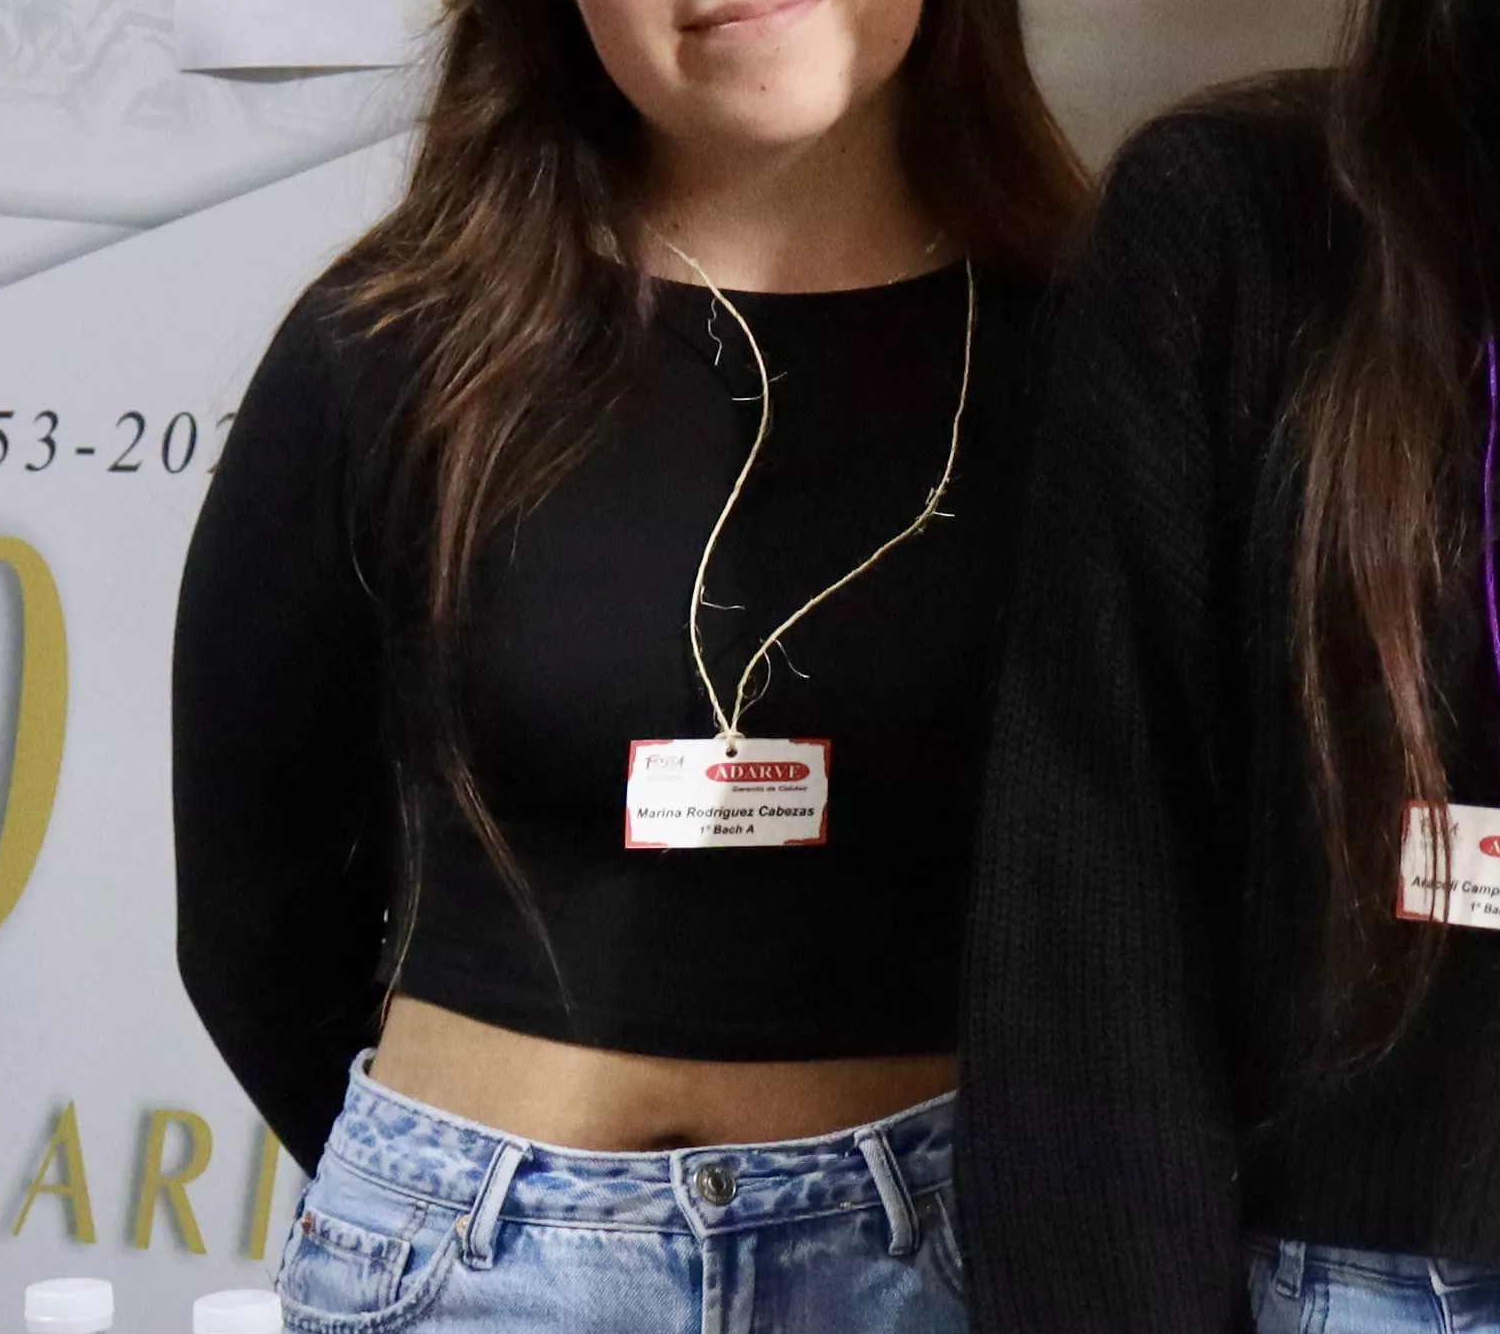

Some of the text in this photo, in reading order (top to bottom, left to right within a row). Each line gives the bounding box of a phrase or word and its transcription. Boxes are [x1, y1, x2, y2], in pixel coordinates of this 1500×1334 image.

[714, 763, 802, 780] ADARVE
[637, 807, 682, 819] Marina
[758, 805, 815, 817] Cabezas
[713, 824, 743, 835] Bach
[746, 824, 755, 834] A
